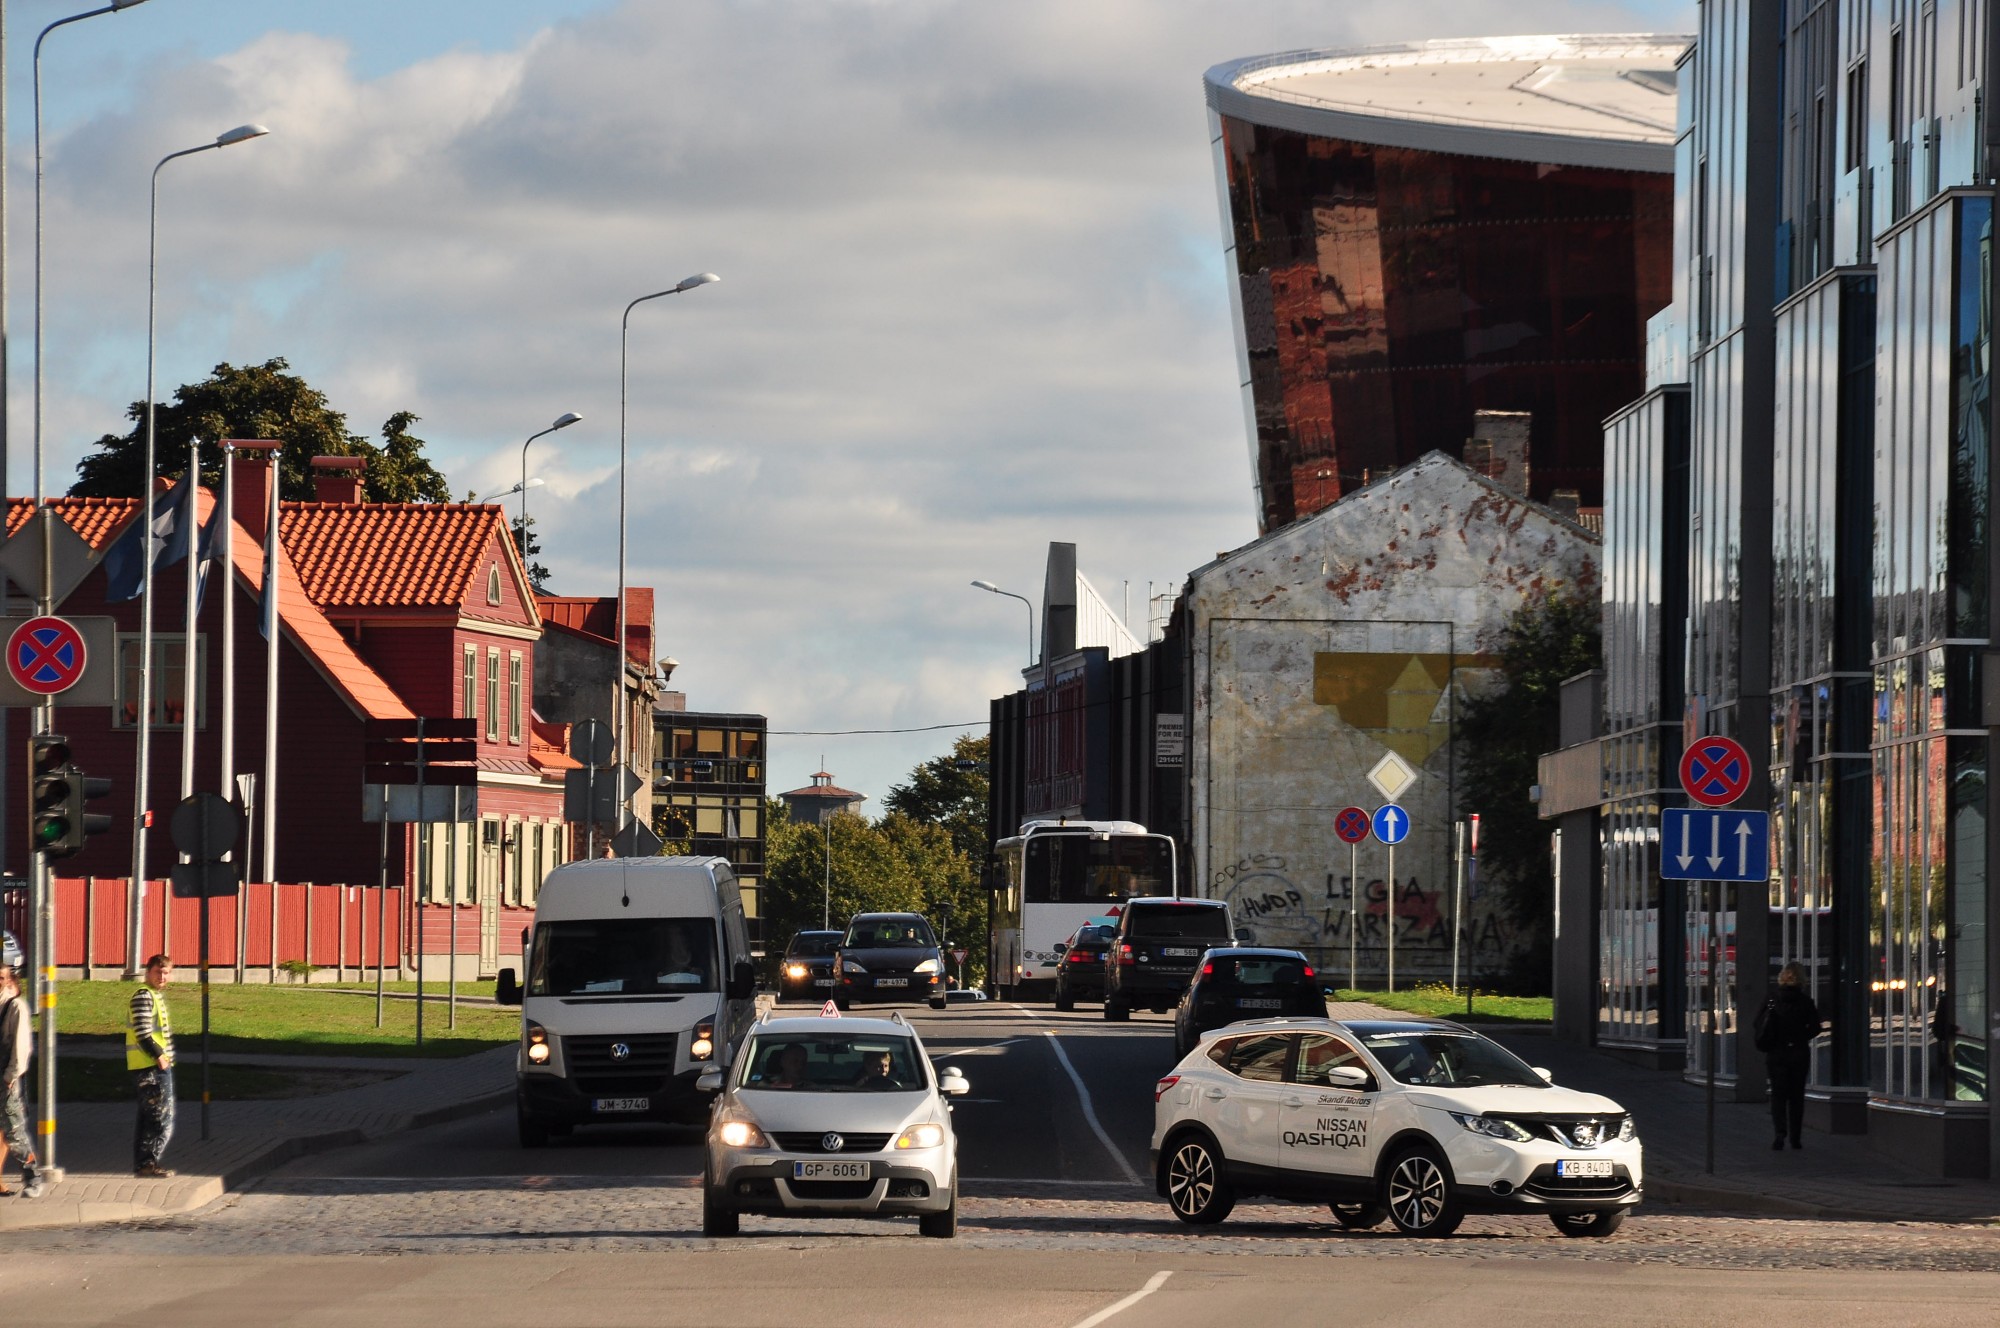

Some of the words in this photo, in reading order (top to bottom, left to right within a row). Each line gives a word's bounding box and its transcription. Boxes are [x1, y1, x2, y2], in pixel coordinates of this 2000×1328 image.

[1326, 873, 1426, 903] LEGIA
[1242, 890, 1301, 918] HWDP
[599, 1099, 648, 1110] JM-3740
[1317, 1094, 1347, 1104] Skandi
[1345, 1096, 1372, 1106] Motors
[1316, 1118, 1367, 1133] NISSAN
[1282, 1131, 1367, 1150] QASHQAI
[804, 1164, 866, 1177] GP-6061
[1565, 1162, 1611, 1174] KB-8403
